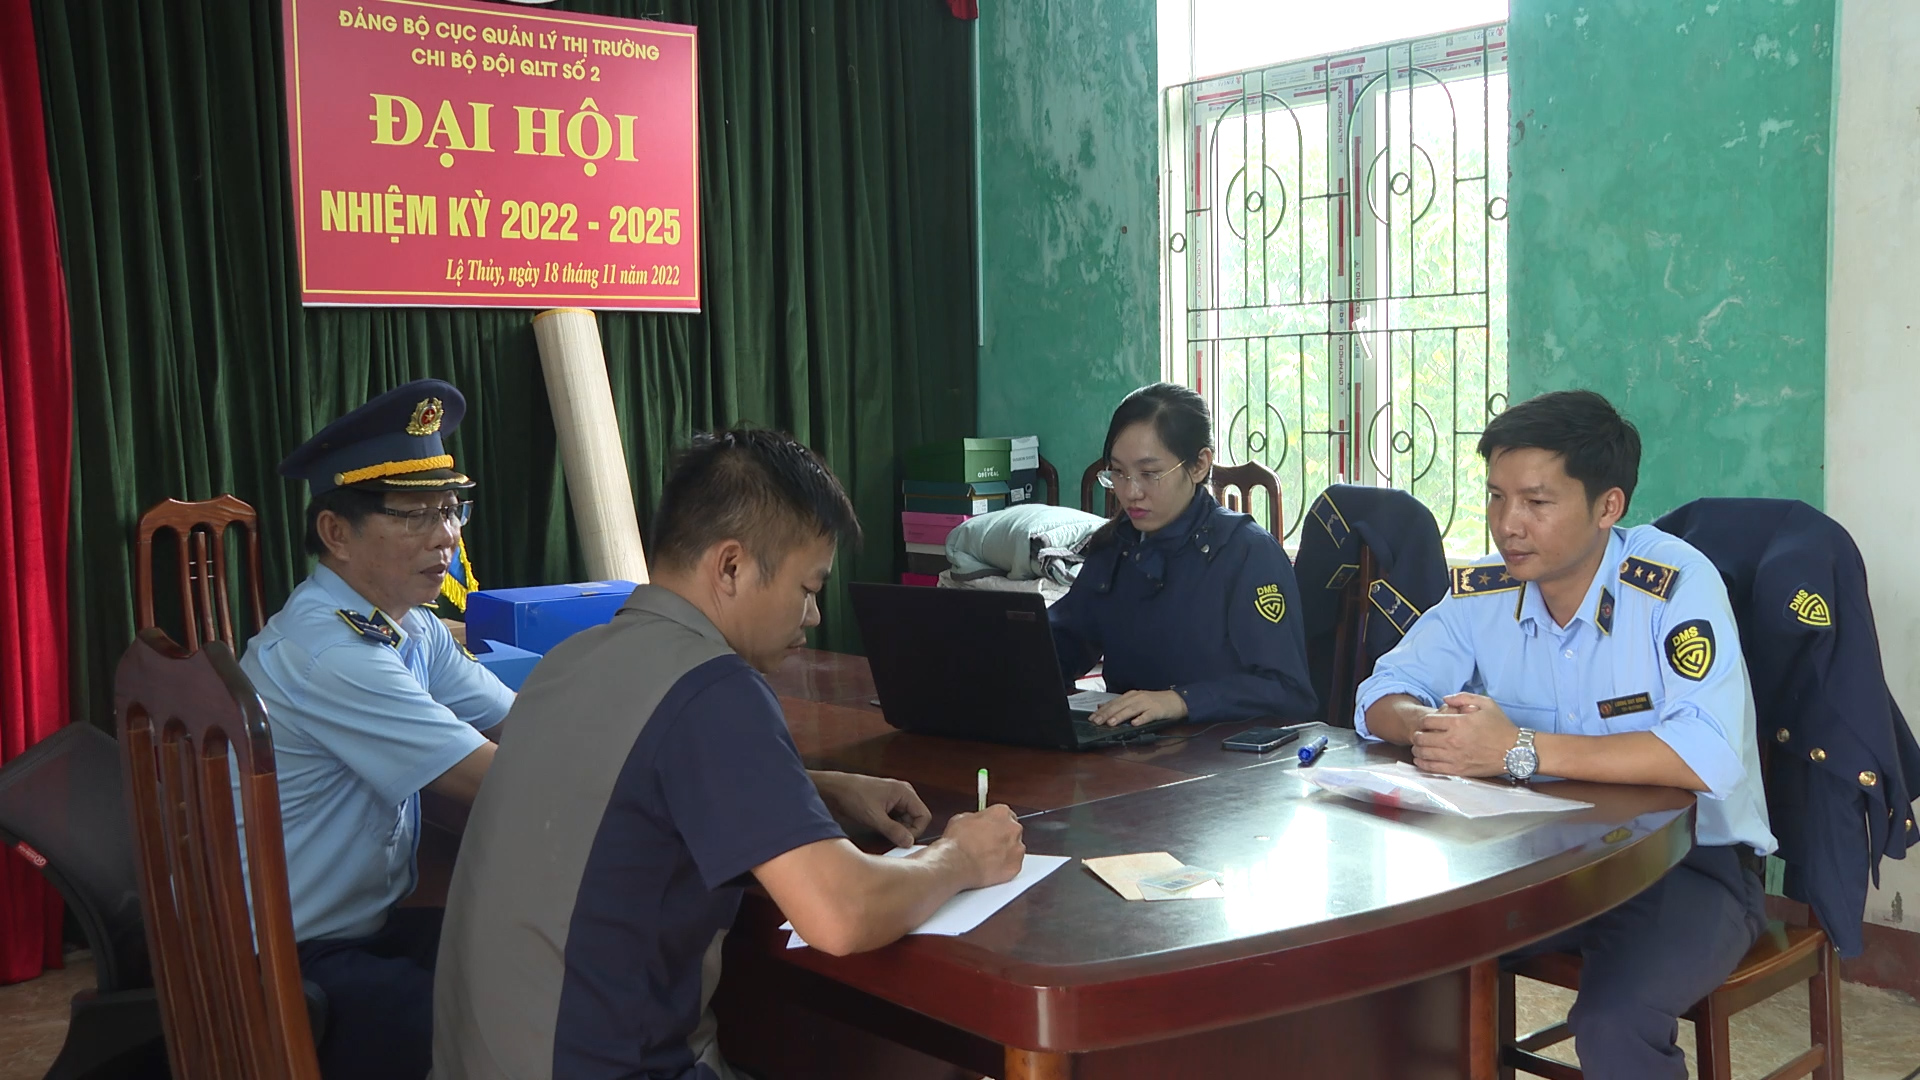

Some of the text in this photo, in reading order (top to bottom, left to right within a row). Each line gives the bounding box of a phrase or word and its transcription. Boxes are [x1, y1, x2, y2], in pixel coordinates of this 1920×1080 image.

[339, 7, 659, 60] ĐẢNG BỘ CỤC QUẢN LÝ THỊ TRƯỜNG
[412, 48, 600, 81] CHI BỘ ĐỘI QLTT SỐ 2
[369, 93, 638, 176] ĐẠI HỘI
[321, 185, 680, 245] NHIỆM KỲ 2022 - 2025
[446, 259, 680, 288] Lệ Thủy, ngày 18 tháng 11 năm 2022
[1256, 584, 1278, 596] DMS
[1789, 589, 1809, 611] DMS
[1672, 626, 1699, 647] DMS
